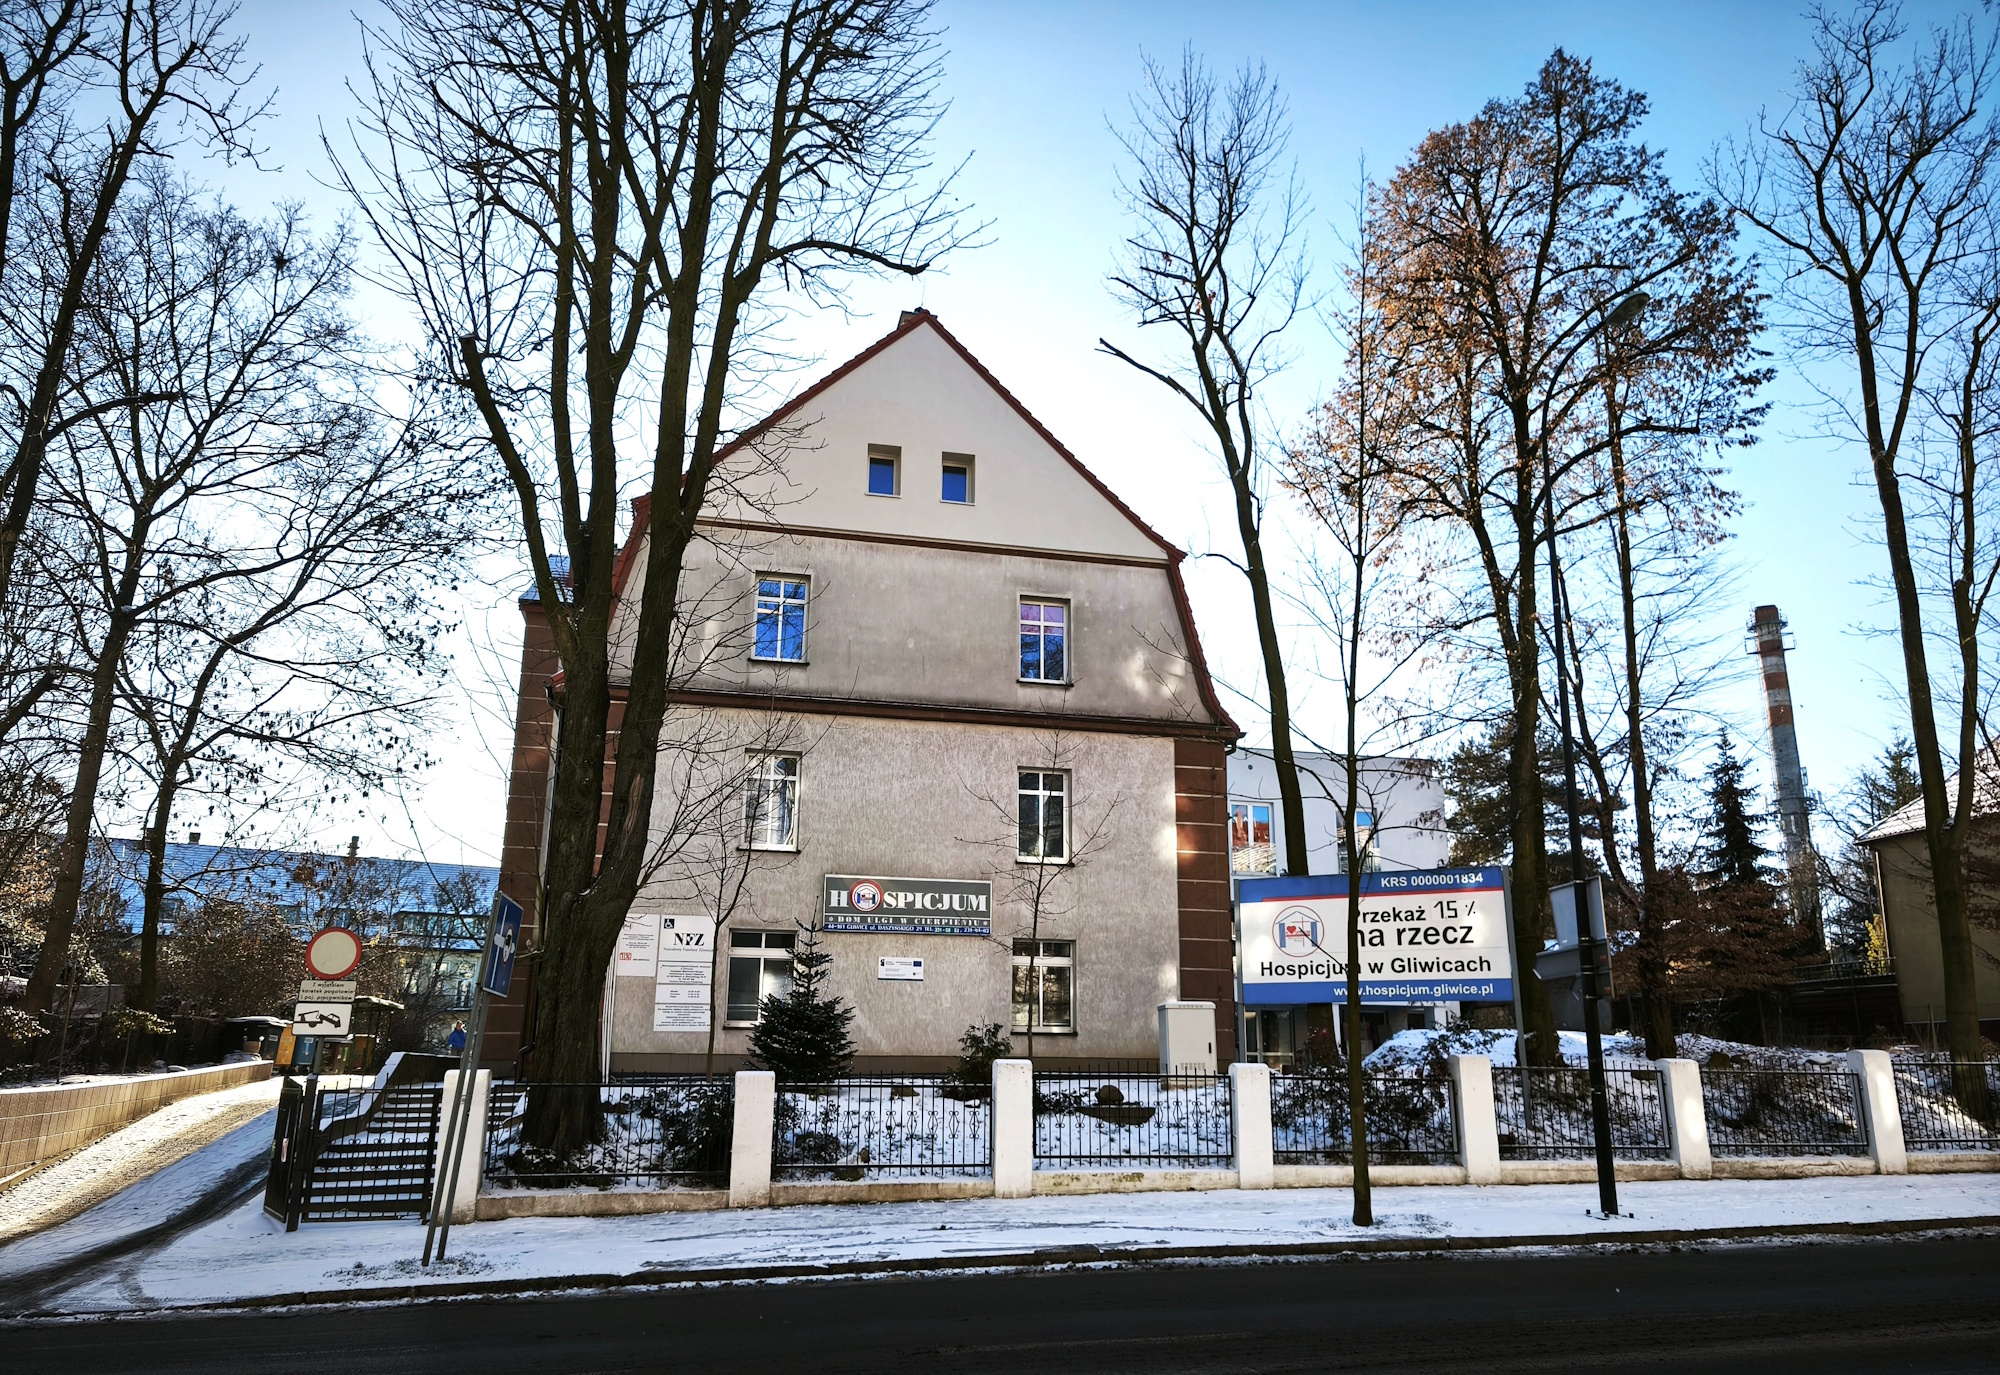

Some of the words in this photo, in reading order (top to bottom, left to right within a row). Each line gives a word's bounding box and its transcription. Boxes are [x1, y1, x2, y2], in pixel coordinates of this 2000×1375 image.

[1381, 877, 1407, 887] KRS
[867, 916, 893, 924] ULGI
[914, 918, 980, 926] CIERPIENIU
[1358, 905, 1426, 923] rzekaż
[1396, 924, 1474, 946] rzecz
[1367, 962, 1384, 974] w
[1390, 956, 1491, 974] Gliwicach
